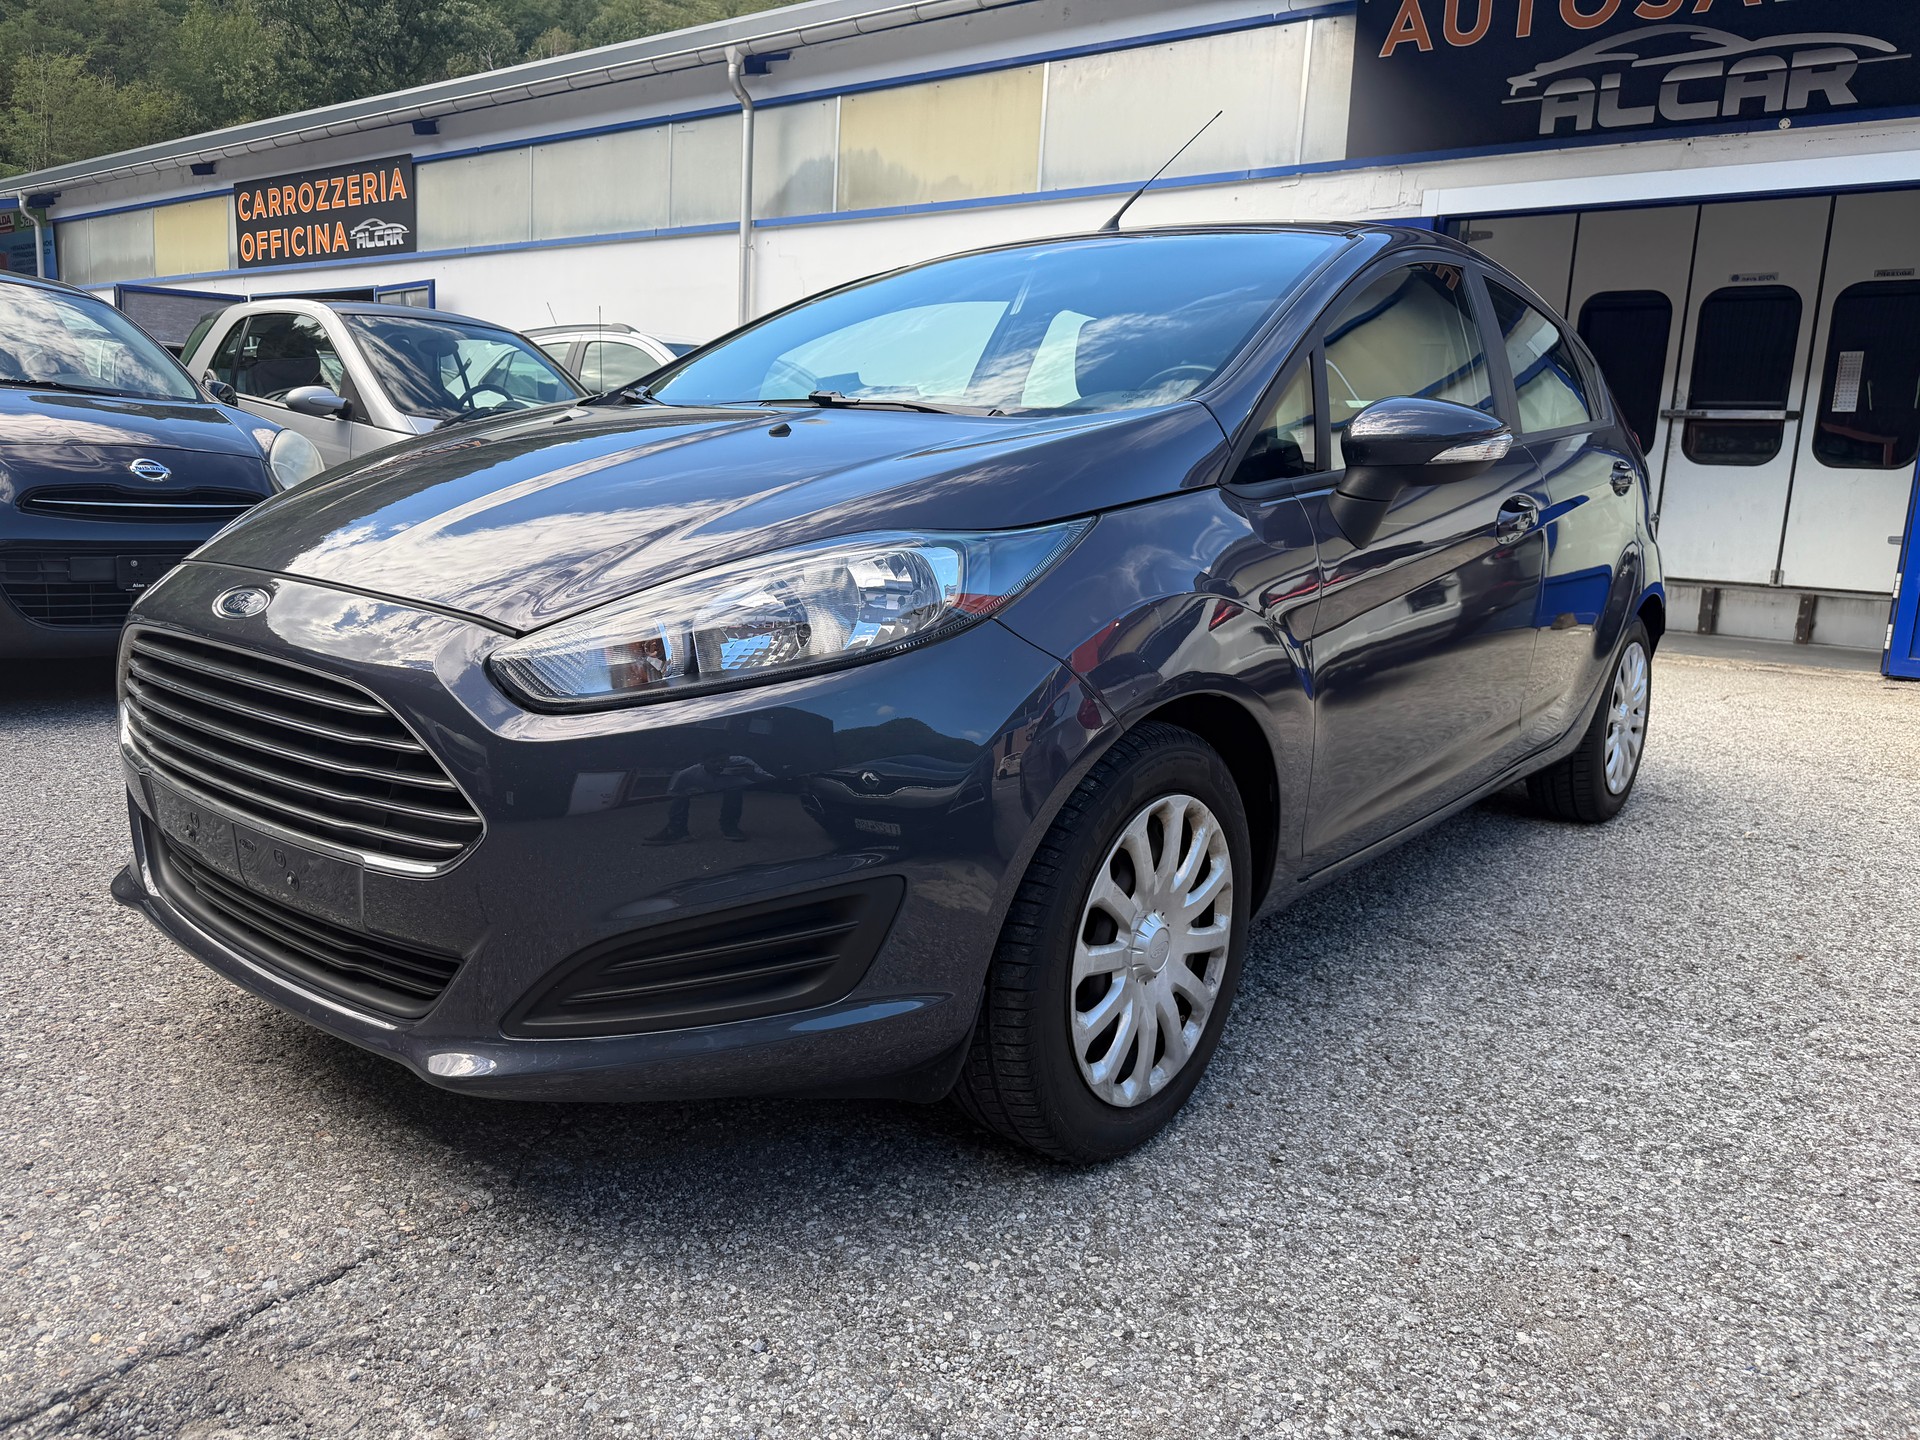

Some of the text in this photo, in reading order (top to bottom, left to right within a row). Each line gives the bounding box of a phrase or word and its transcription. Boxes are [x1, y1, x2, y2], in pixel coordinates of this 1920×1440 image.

[1538, 46, 1859, 135] ALCAR
[238, 167, 408, 222] CARROZZERIA
[240, 221, 404, 262] OFFICINA ALCAR
